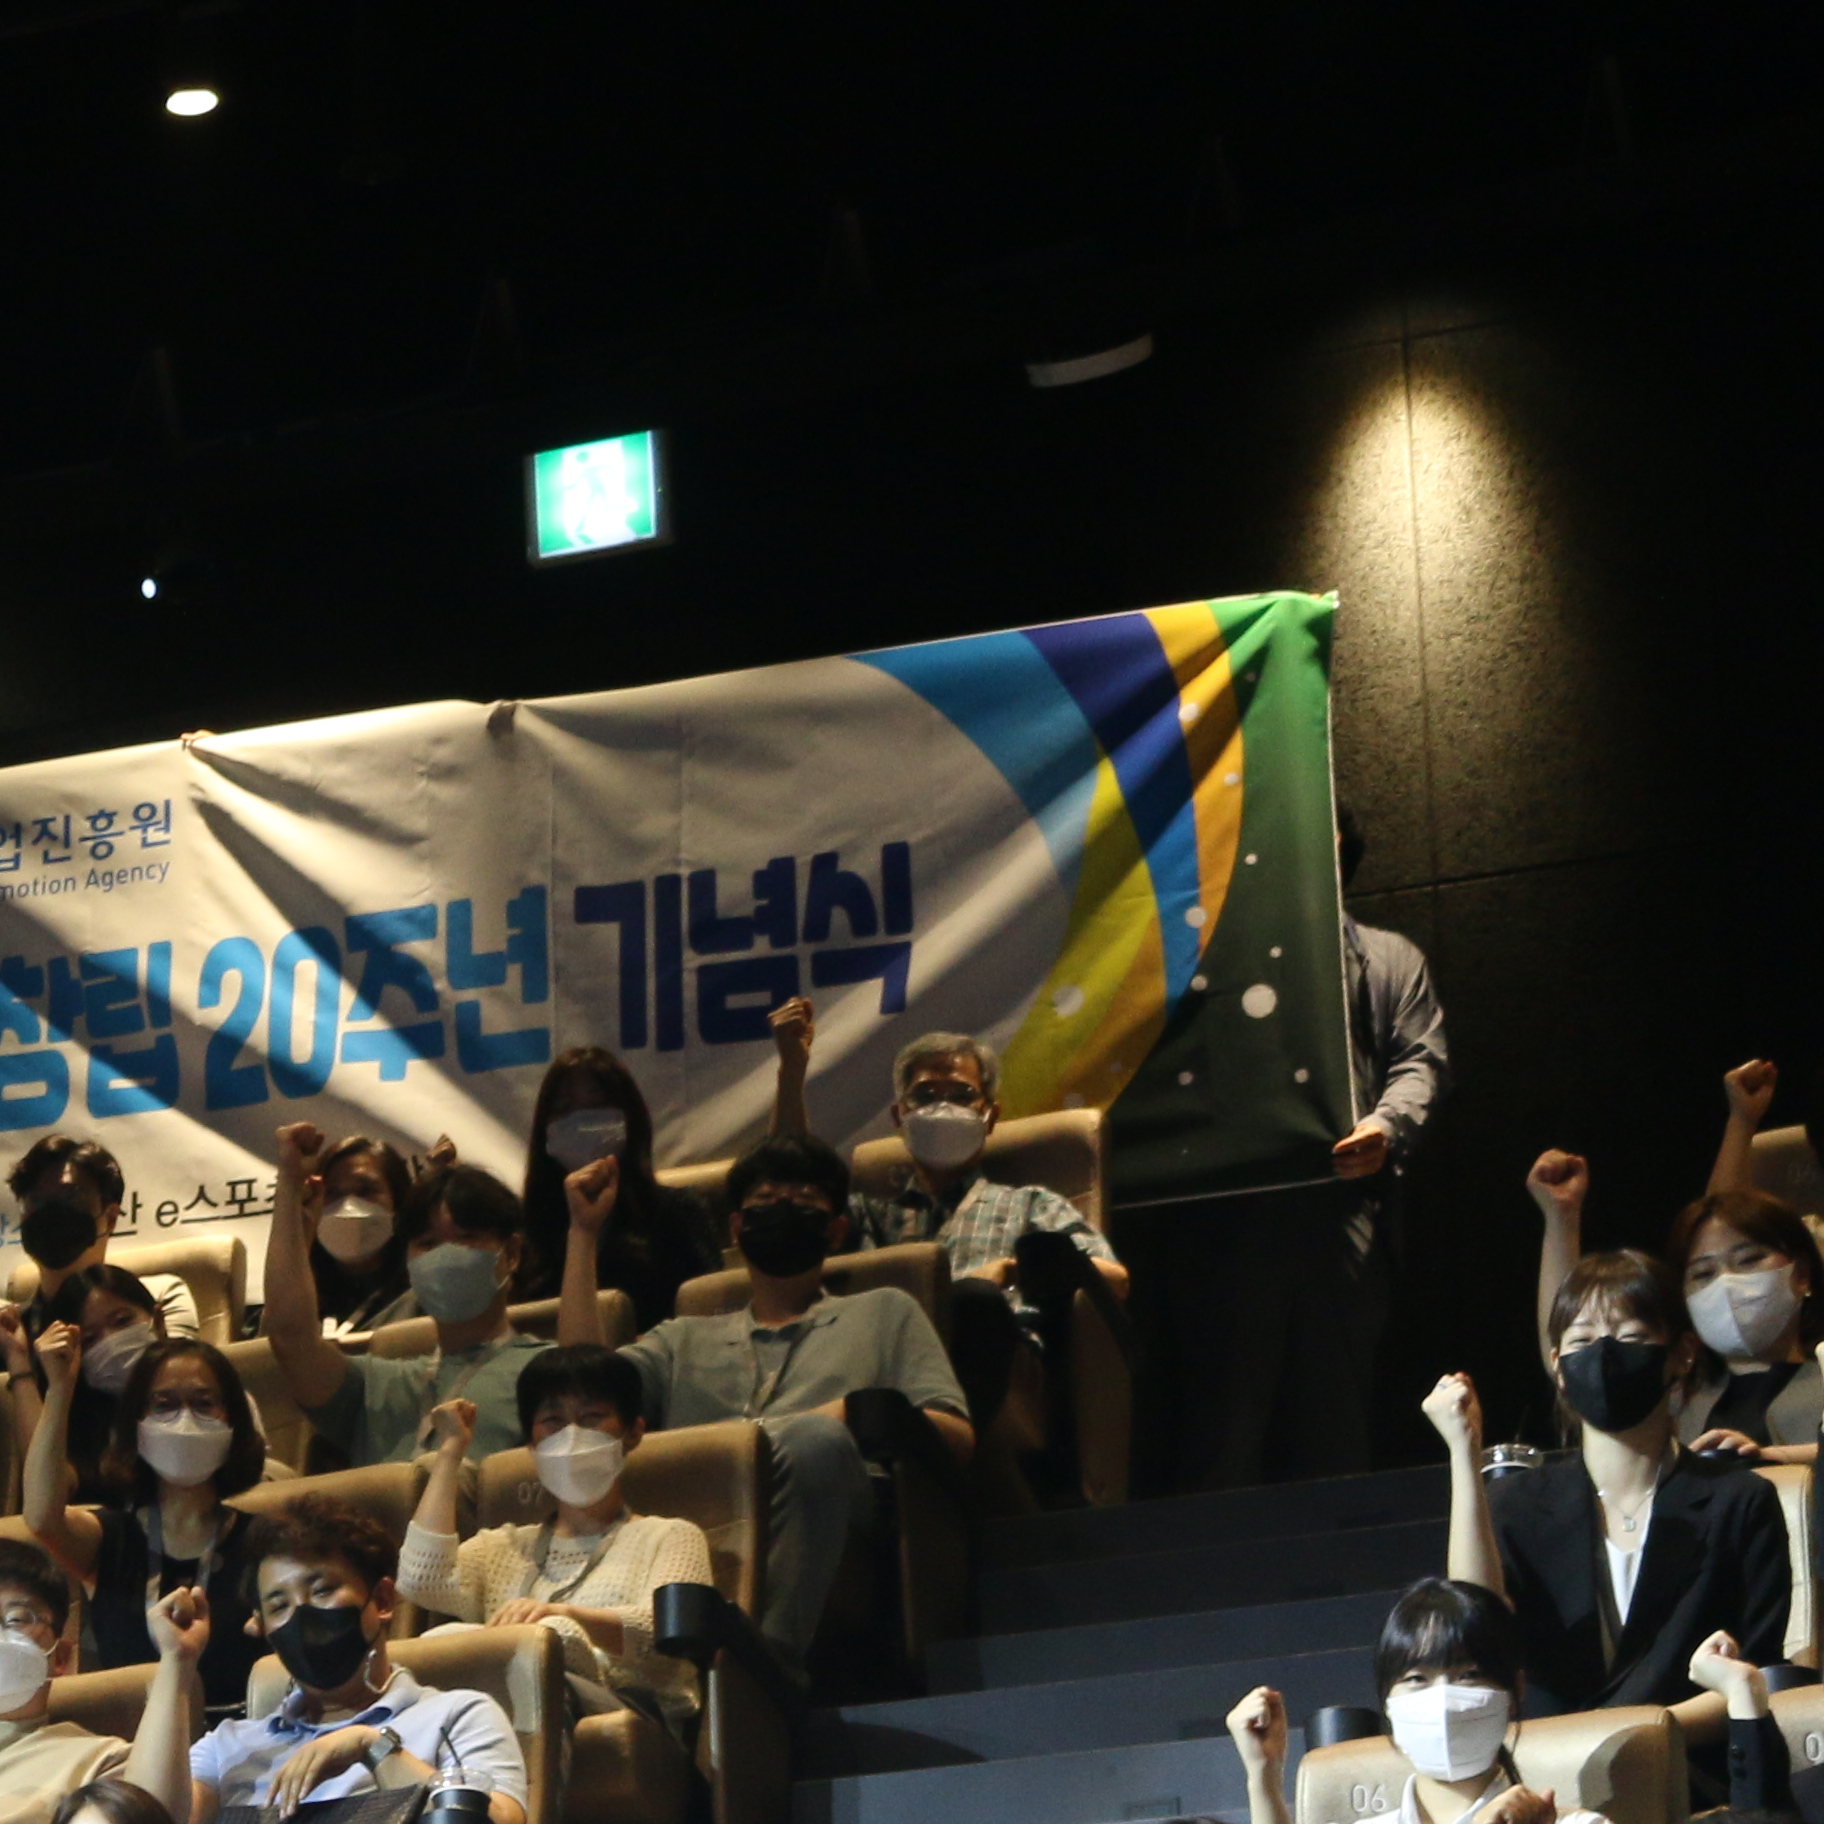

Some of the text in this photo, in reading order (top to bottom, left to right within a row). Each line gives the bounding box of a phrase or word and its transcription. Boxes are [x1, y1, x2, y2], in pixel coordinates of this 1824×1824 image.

[84, 861, 171, 893] Agency
[198, 886, 550, 1112] 20주년
[574, 841, 912, 1051] 기념식
[1351, 1783, 1389, 1814] 06
